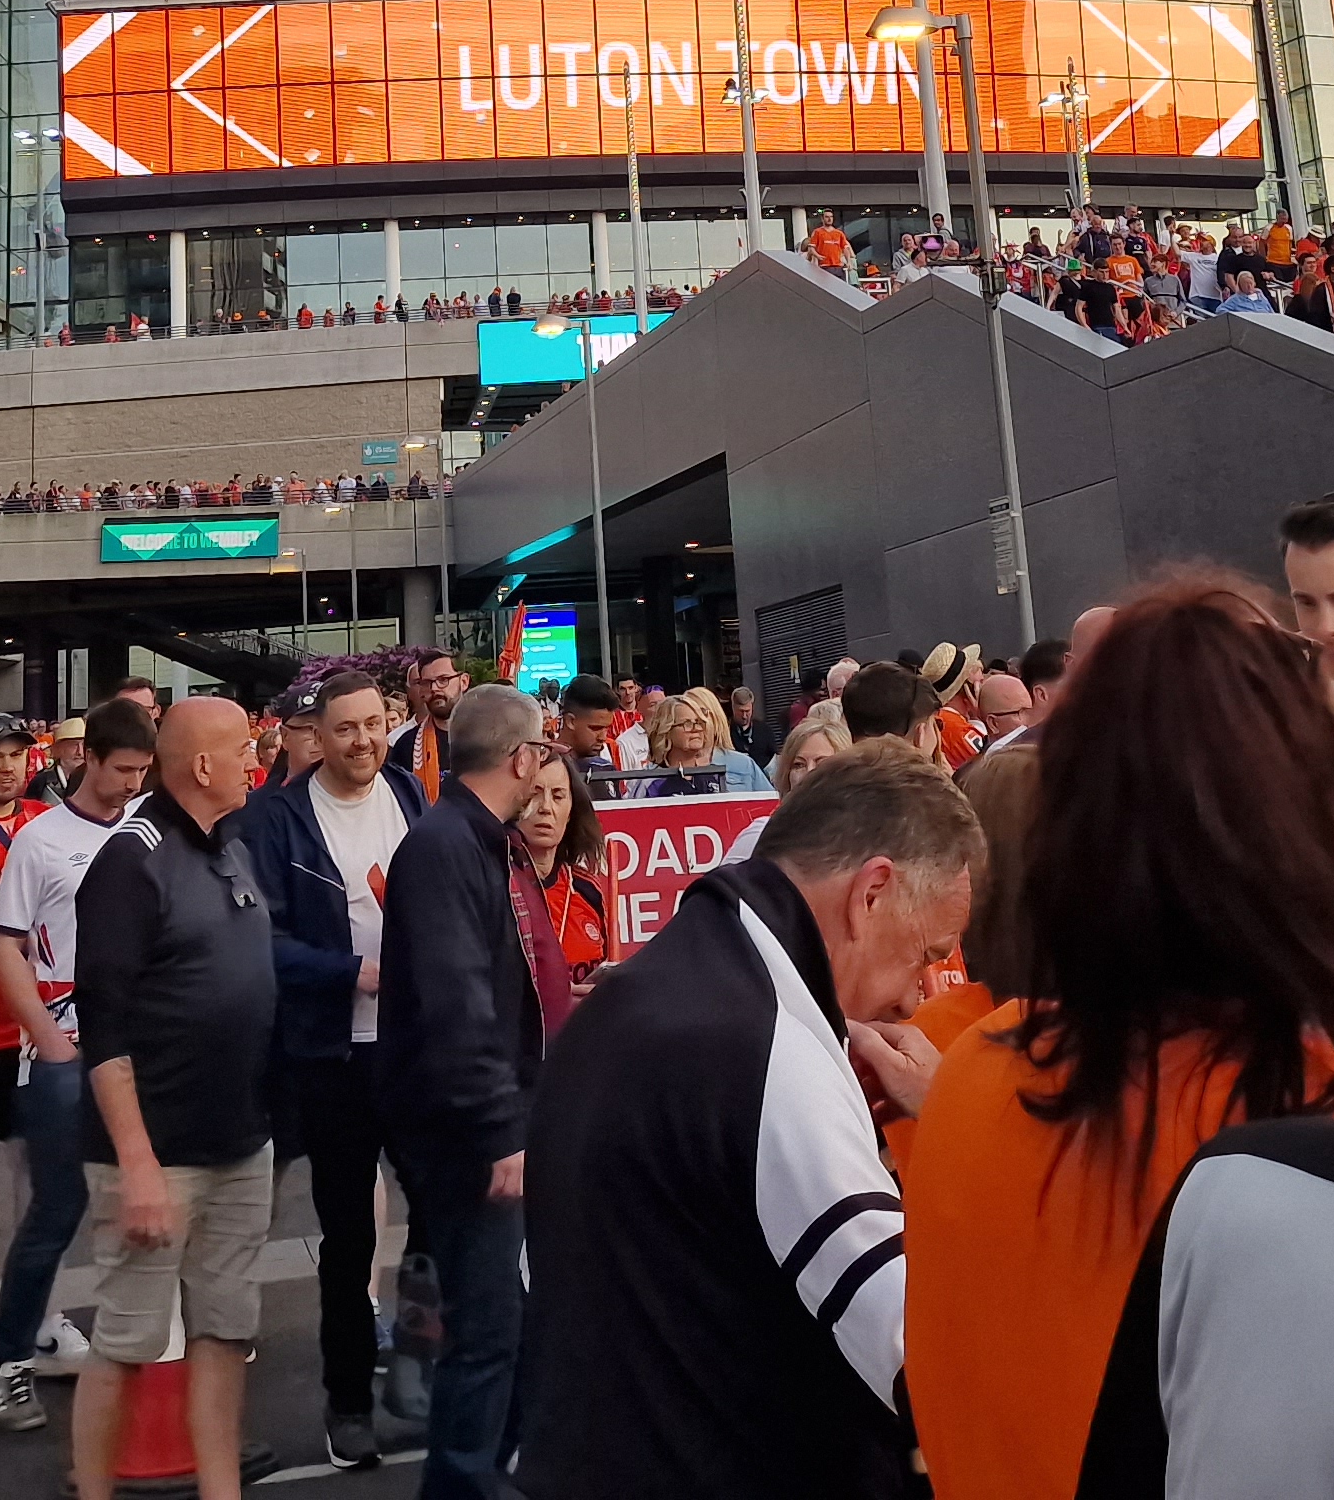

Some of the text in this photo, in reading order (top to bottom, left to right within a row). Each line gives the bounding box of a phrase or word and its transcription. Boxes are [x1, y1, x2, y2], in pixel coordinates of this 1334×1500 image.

[458, 41, 695, 110] LUTON
[120, 530, 260, 550] WELCOME TO WEMBLEY
